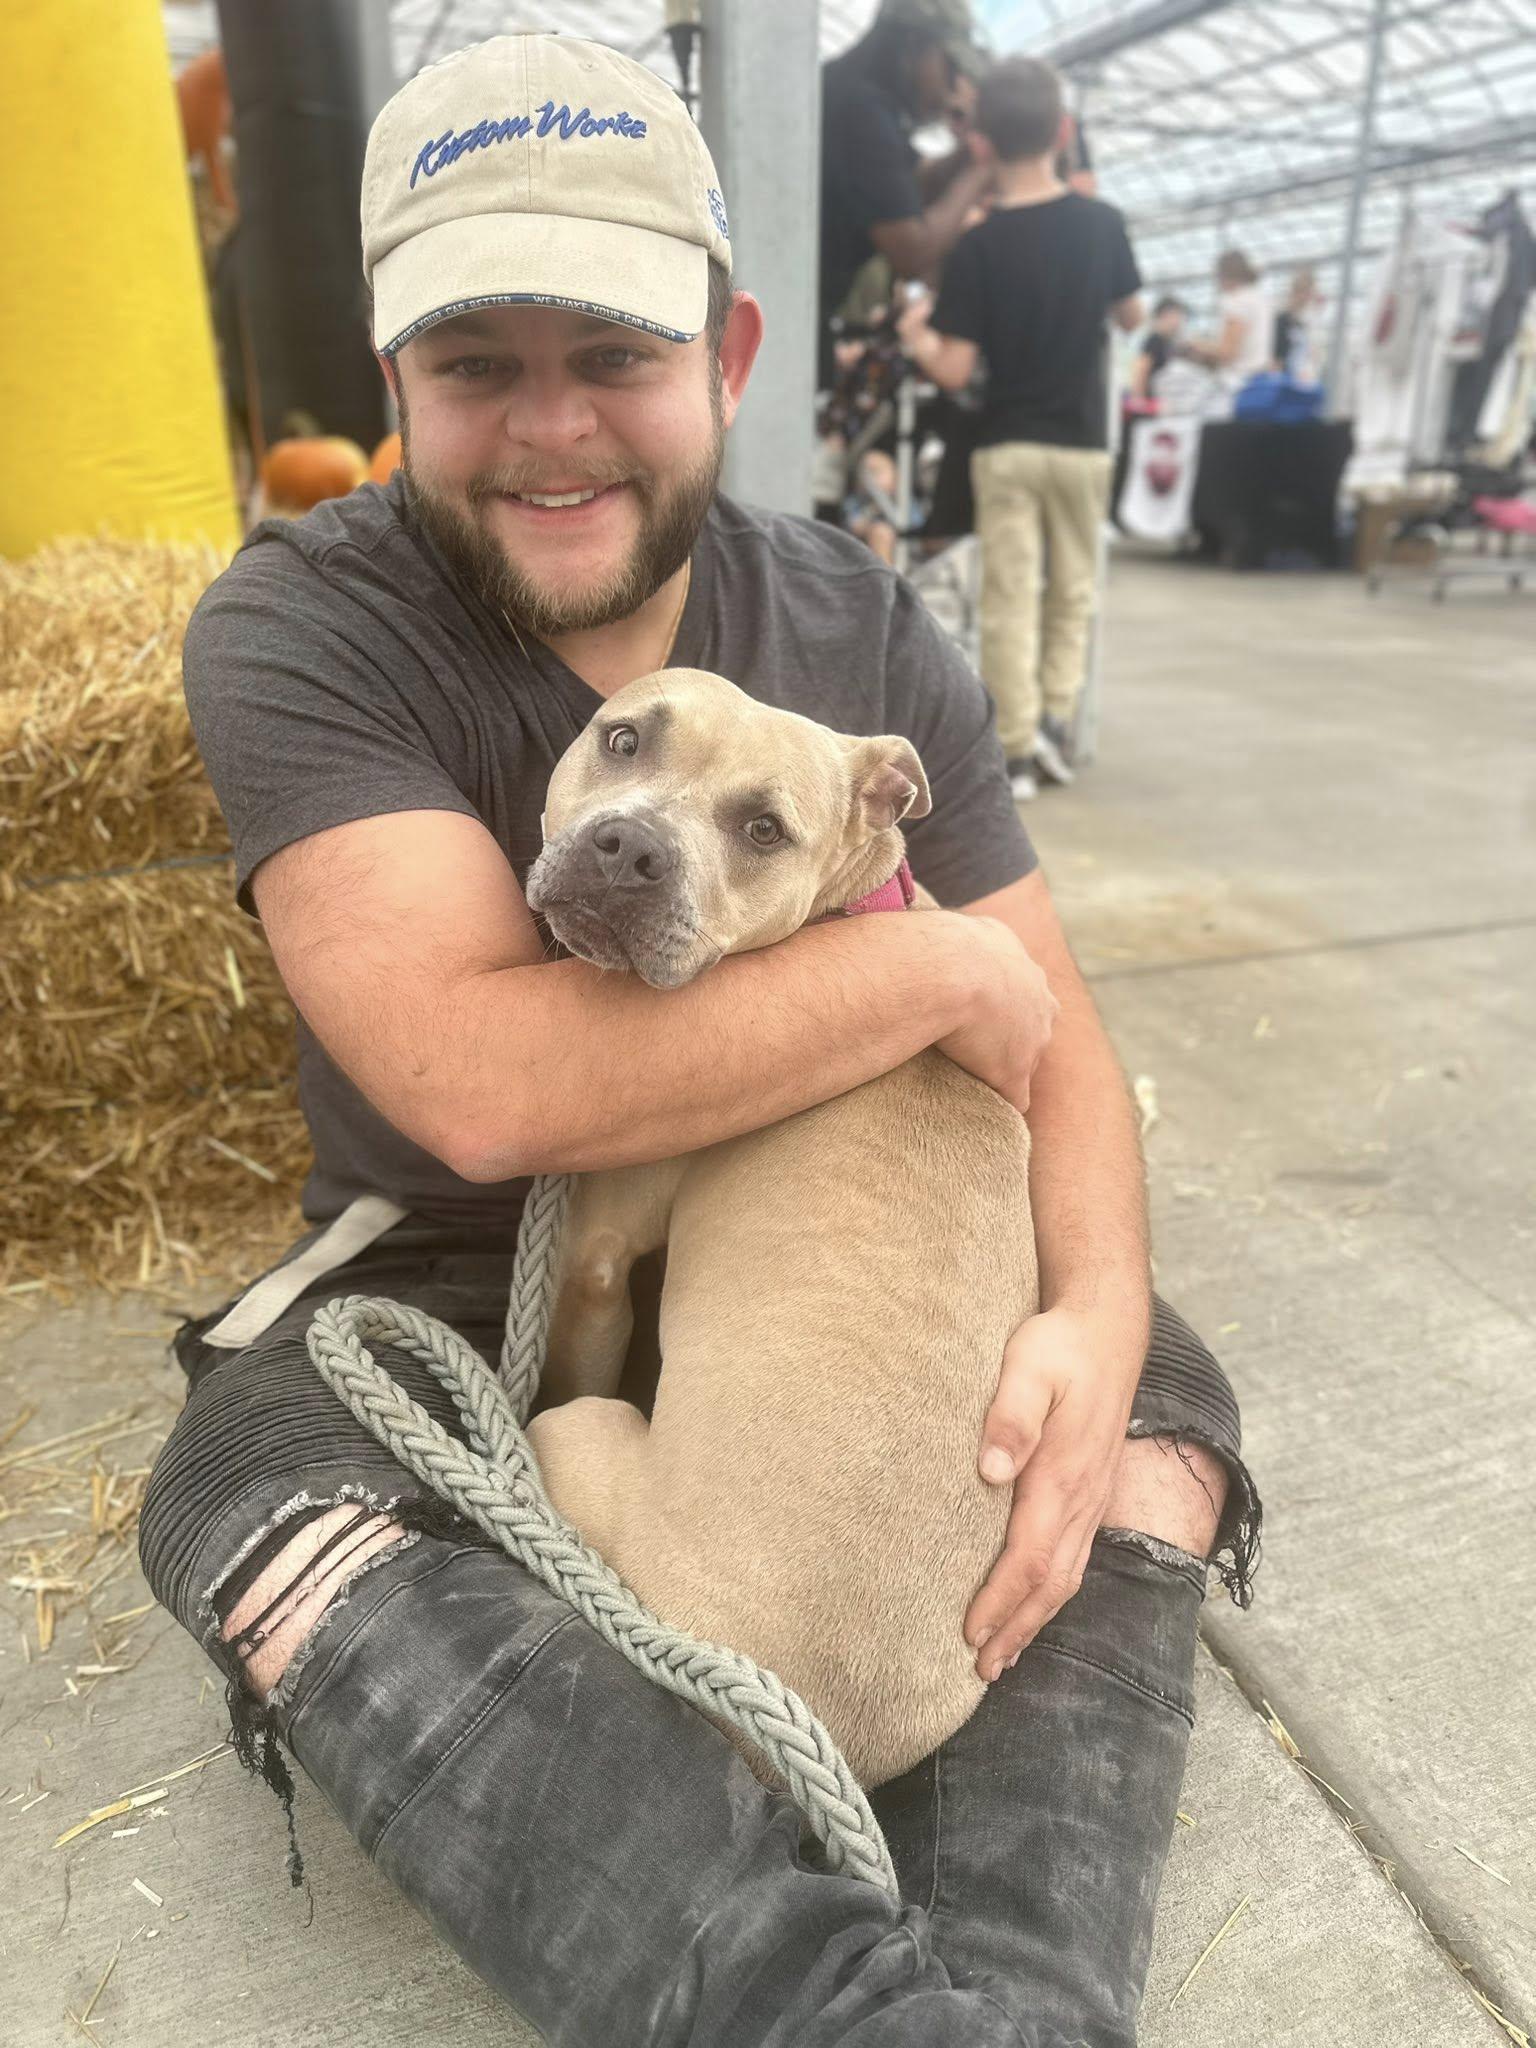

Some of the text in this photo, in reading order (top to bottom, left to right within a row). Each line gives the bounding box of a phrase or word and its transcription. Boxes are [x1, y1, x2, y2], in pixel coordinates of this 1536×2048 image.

[409, 115, 533, 189] Kustom
[397, 325, 417, 344] MAKE
[417, 311, 442, 328] YOUR
[445, 303, 465, 316] CAR
[469, 296, 512, 309] BETTER
[533, 295, 676, 336] WE MAKE YOUR CAR BETTER
